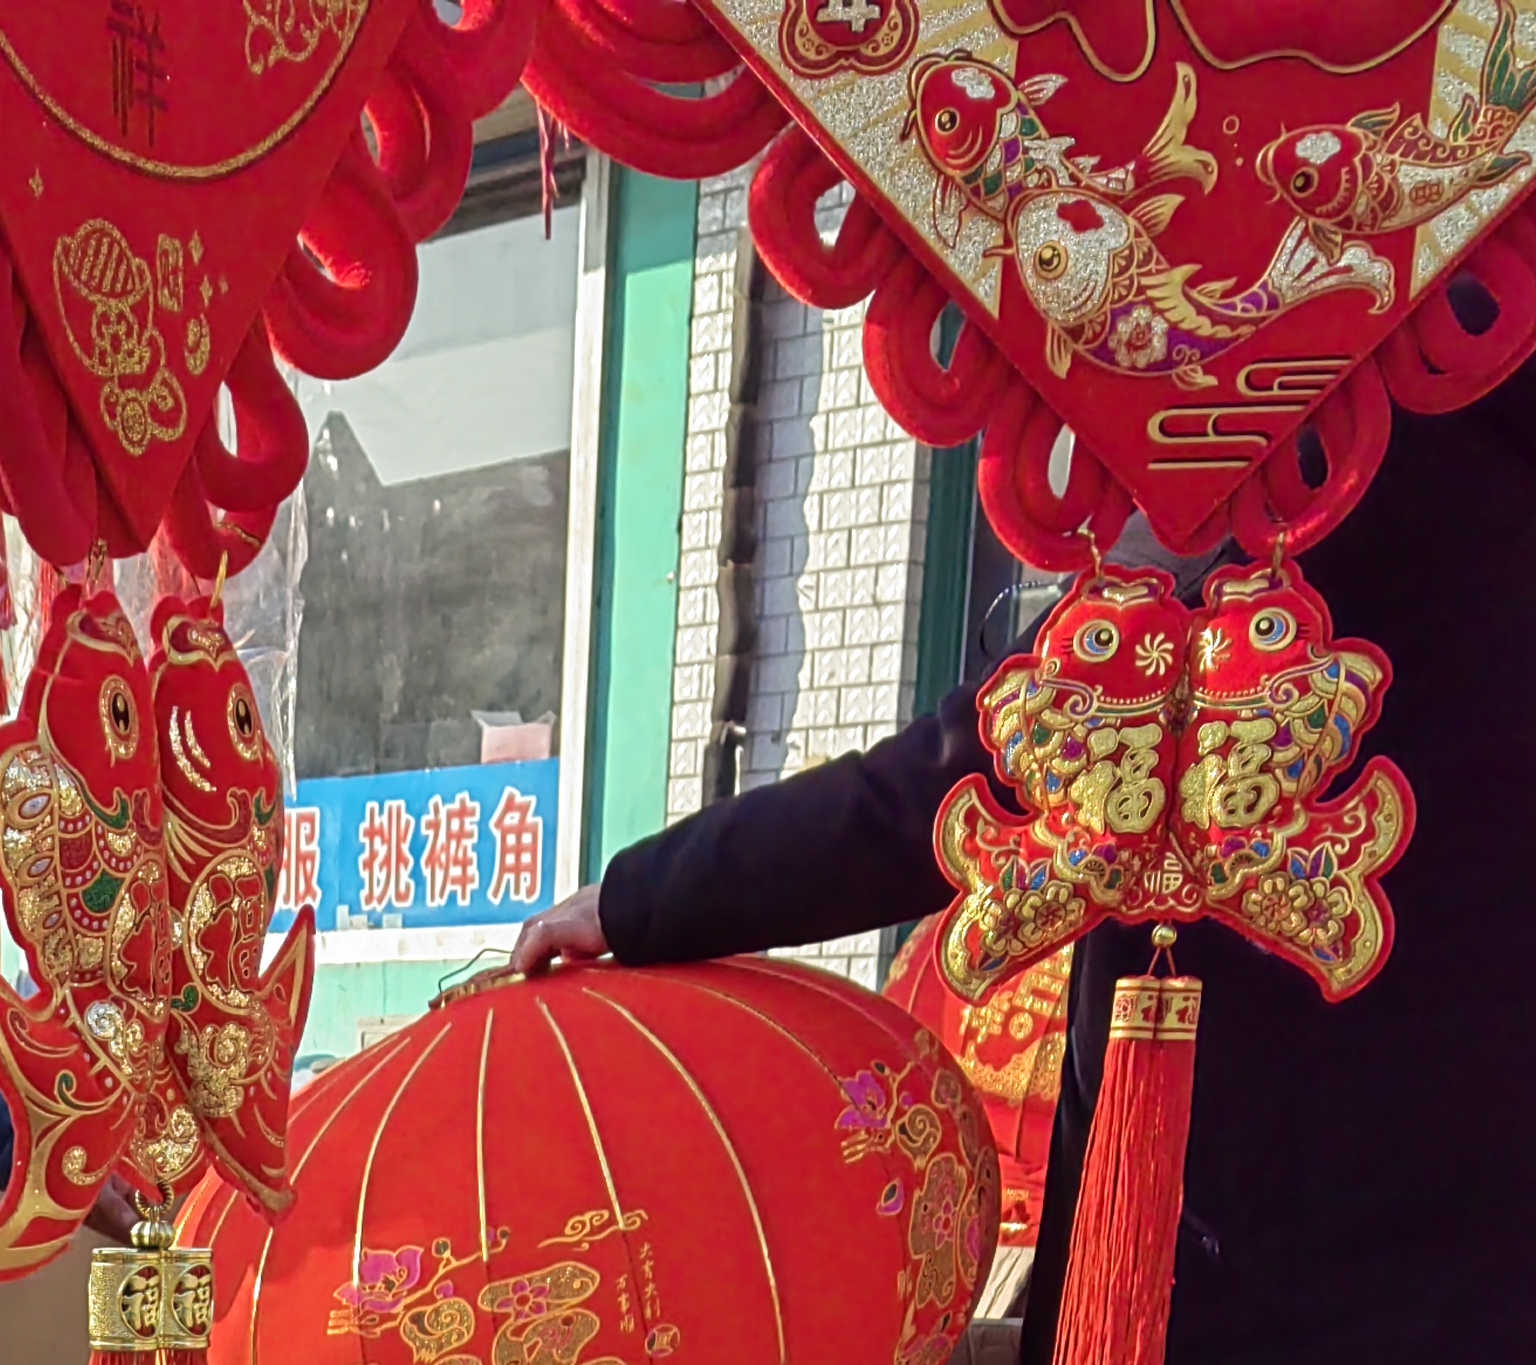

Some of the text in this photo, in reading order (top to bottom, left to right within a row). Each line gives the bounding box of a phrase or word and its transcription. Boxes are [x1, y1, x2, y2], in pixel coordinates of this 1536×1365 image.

[1070, 718, 1280, 835] 福 福
[359, 785, 545, 912] 挑裤角
[1144, 852, 1184, 894] 福
